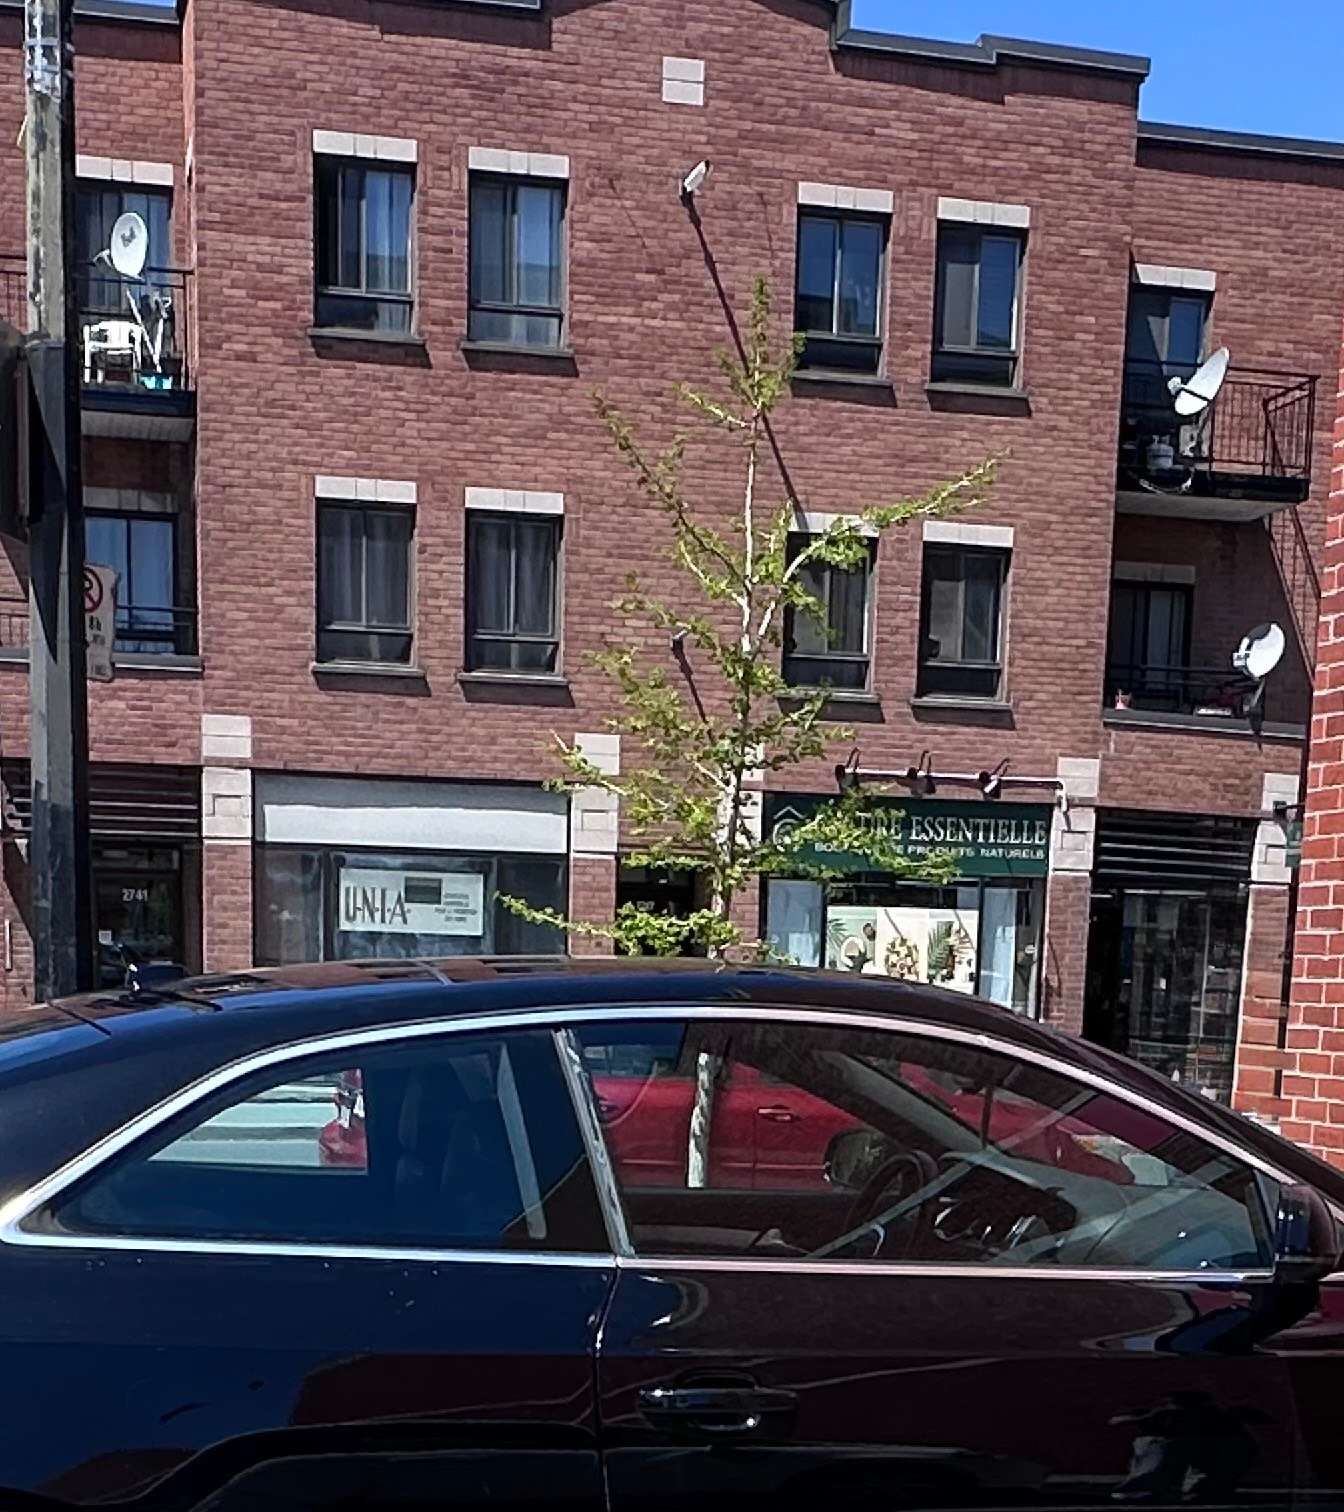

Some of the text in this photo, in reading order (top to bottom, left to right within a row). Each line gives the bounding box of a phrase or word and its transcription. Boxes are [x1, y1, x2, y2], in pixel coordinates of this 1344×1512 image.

[909, 816, 1047, 844] ESSENTIELLE
[980, 848, 1046, 860] NATURELS
[121, 888, 148, 902] 2741
